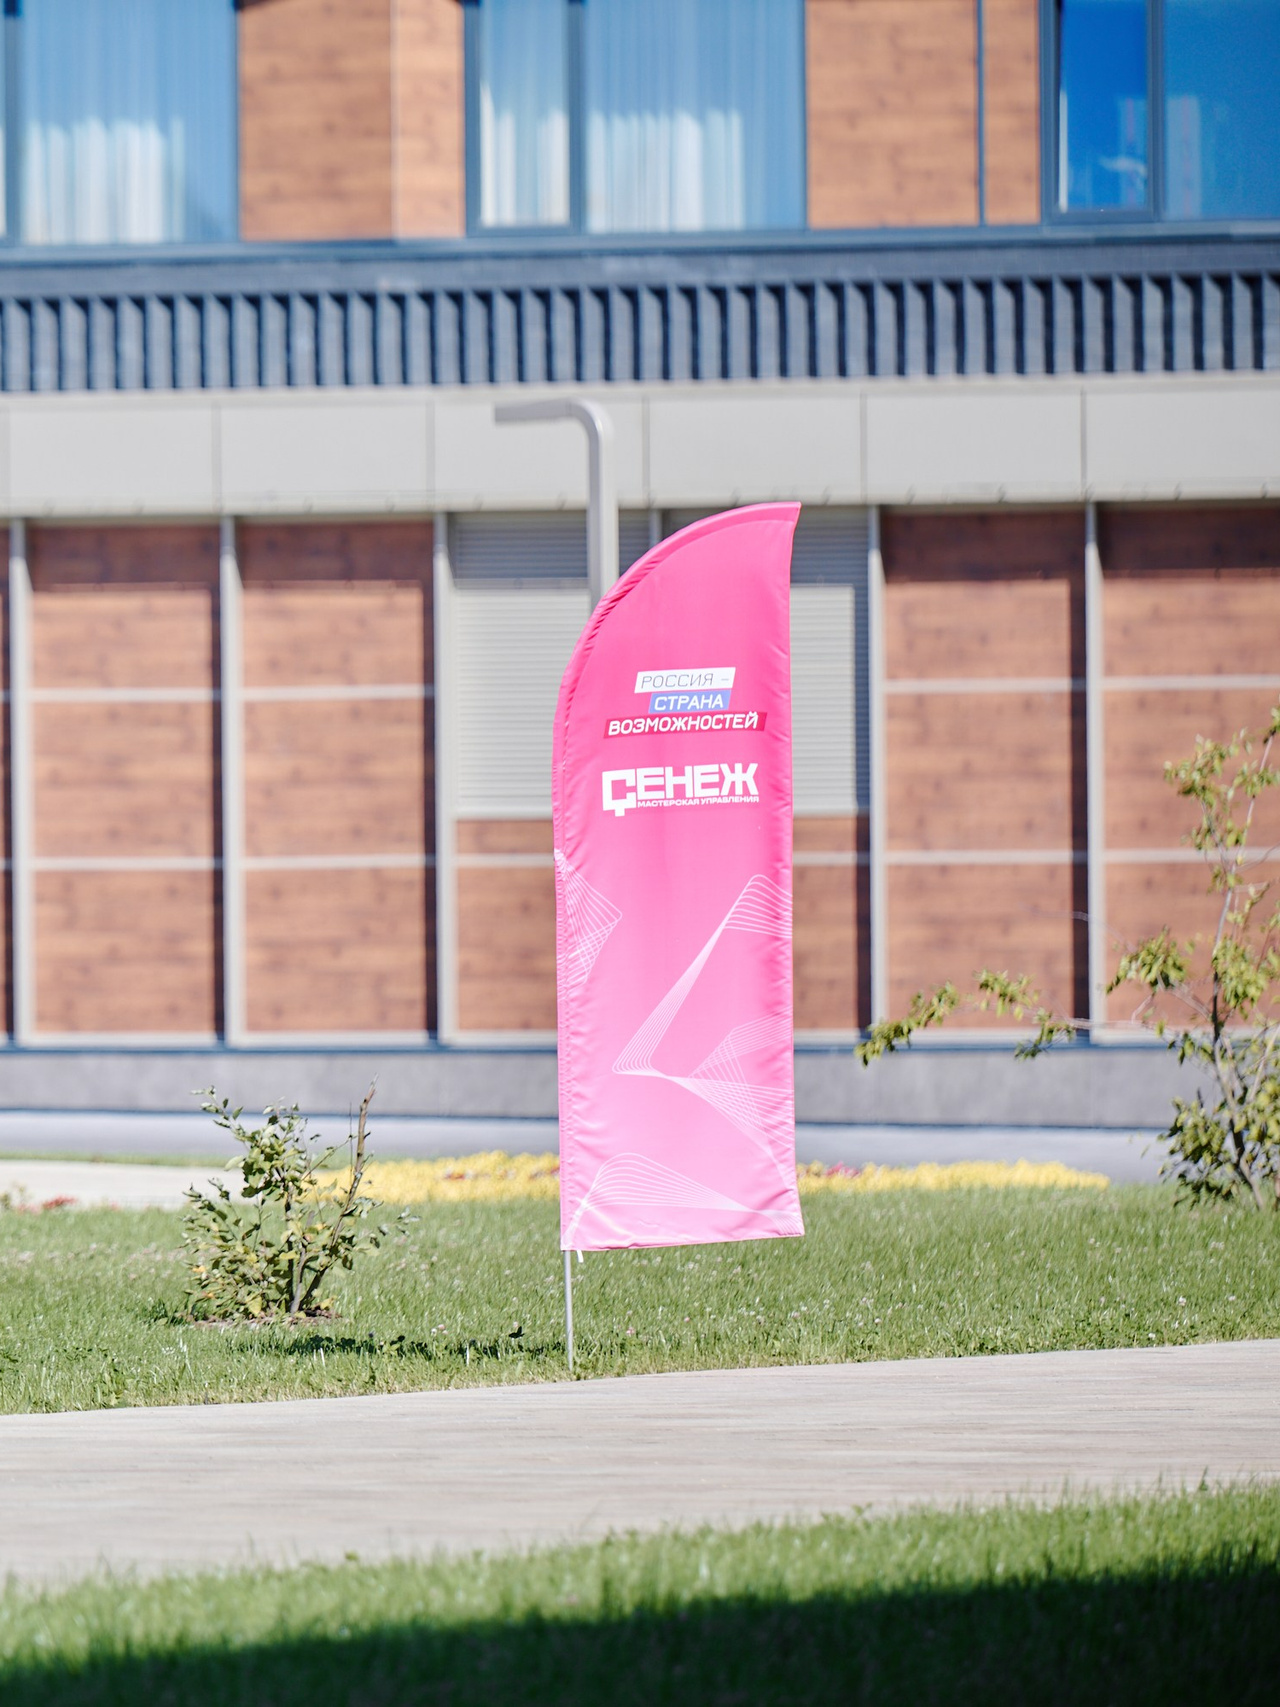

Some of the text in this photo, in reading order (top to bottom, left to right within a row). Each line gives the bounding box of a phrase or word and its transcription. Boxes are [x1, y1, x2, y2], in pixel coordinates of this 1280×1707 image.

[641, 673, 714, 689] РОССИЯ
[654, 694, 724, 711] СТРАНА
[608, 711, 759, 736] ВОЗМОЖНОСТЕЙ
[637, 796, 759, 808] МАСТЕРСКАЯ УПРАВЛЕНИЯ
